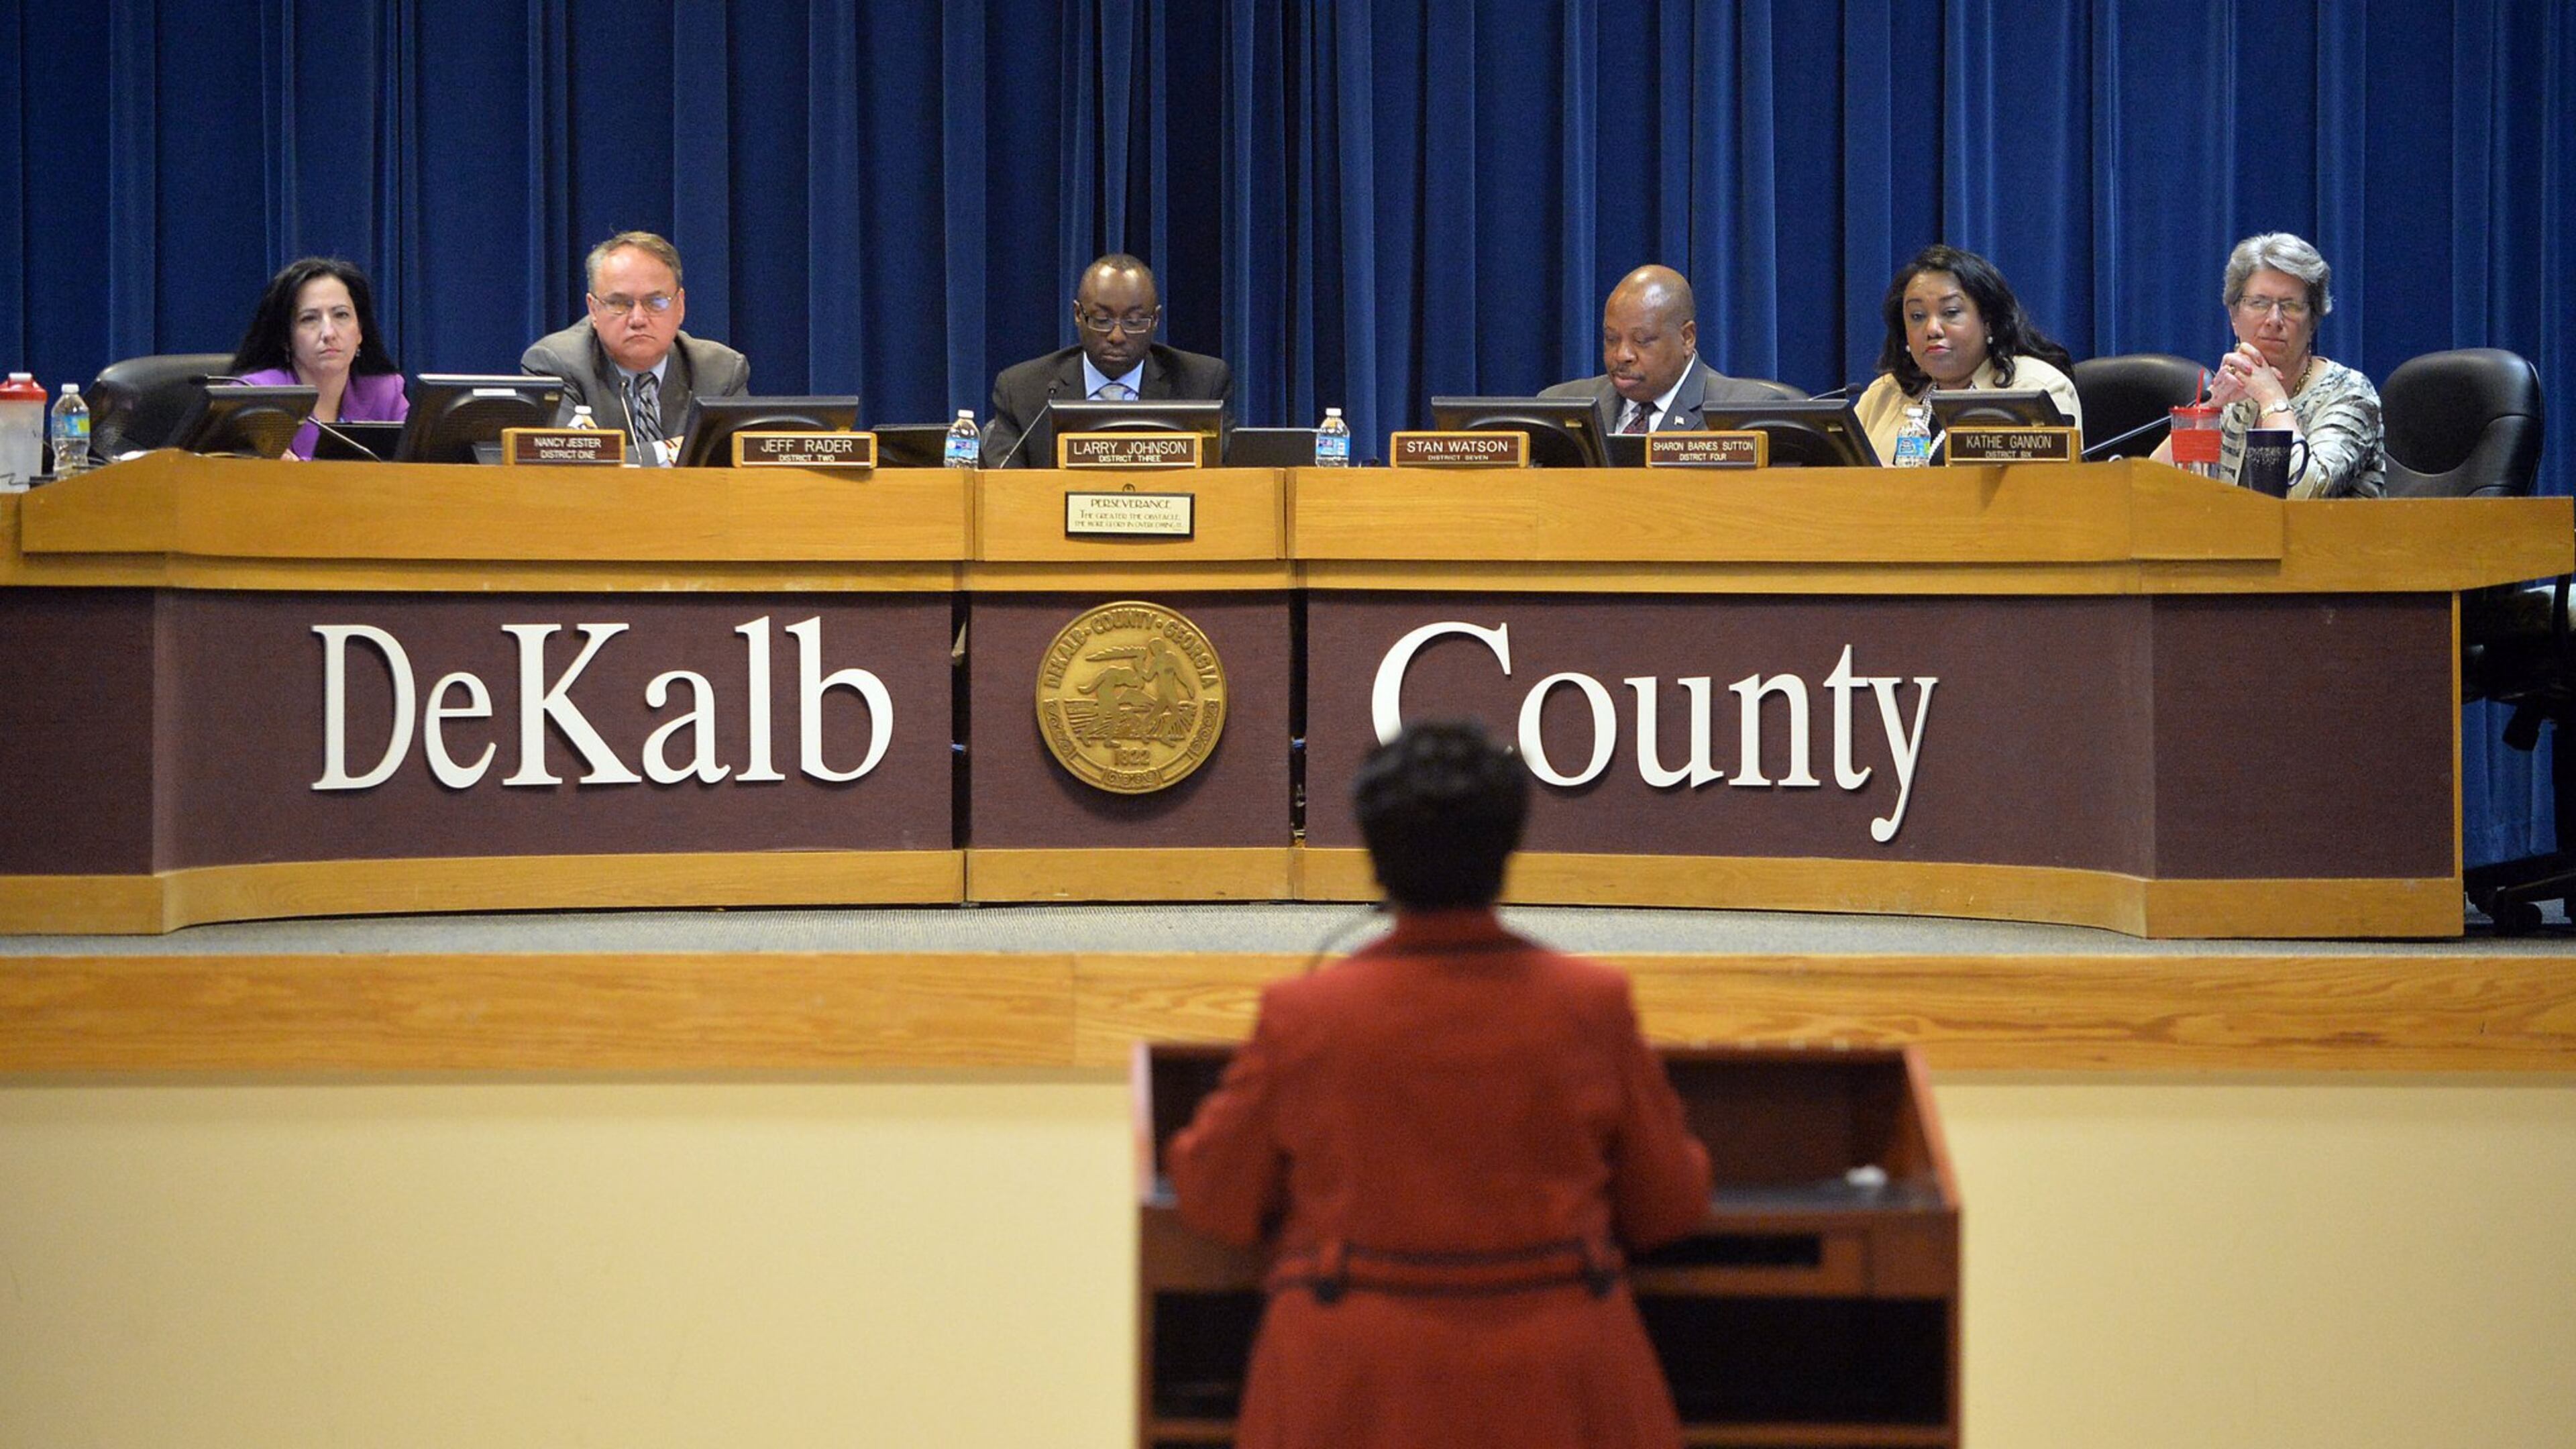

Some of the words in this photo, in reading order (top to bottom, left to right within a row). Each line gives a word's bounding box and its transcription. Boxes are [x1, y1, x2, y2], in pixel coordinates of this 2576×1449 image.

[534, 437, 565, 447] NANCY
[566, 438, 602, 448] JESTER
[761, 439, 795, 453] JEFF
[805, 439, 853, 453] RADER
[1407, 441, 1443, 453] STAN
[1448, 441, 1508, 453] WATSON
[1653, 441, 1684, 451] SHARON
[1688, 441, 1718, 451] BARNES
[1723, 441, 1754, 451] SUTTON
[1966, 435, 2003, 449] KATHIE
[2010, 435, 2052, 449] GANNON
[1073, 441, 1118, 455] LARRY
[1127, 441, 1187, 455] JOHNSON
[540, 449, 576, 459] DISTRICT
[578, 450, 596, 460] ONE
[778, 454, 812, 462] DISTRICT
[1986, 451, 2017, 459] DISTRICT
[1091, 498, 1171, 508] PERSEVERANCE
[1044, 627, 1087, 689] DEKALB
[1091, 608, 1158, 635] COUNTY
[1163, 619, 1219, 690] GEORGIA
[311, 616, 894, 790] DeKalb
[1372, 621, 1939, 842] County
